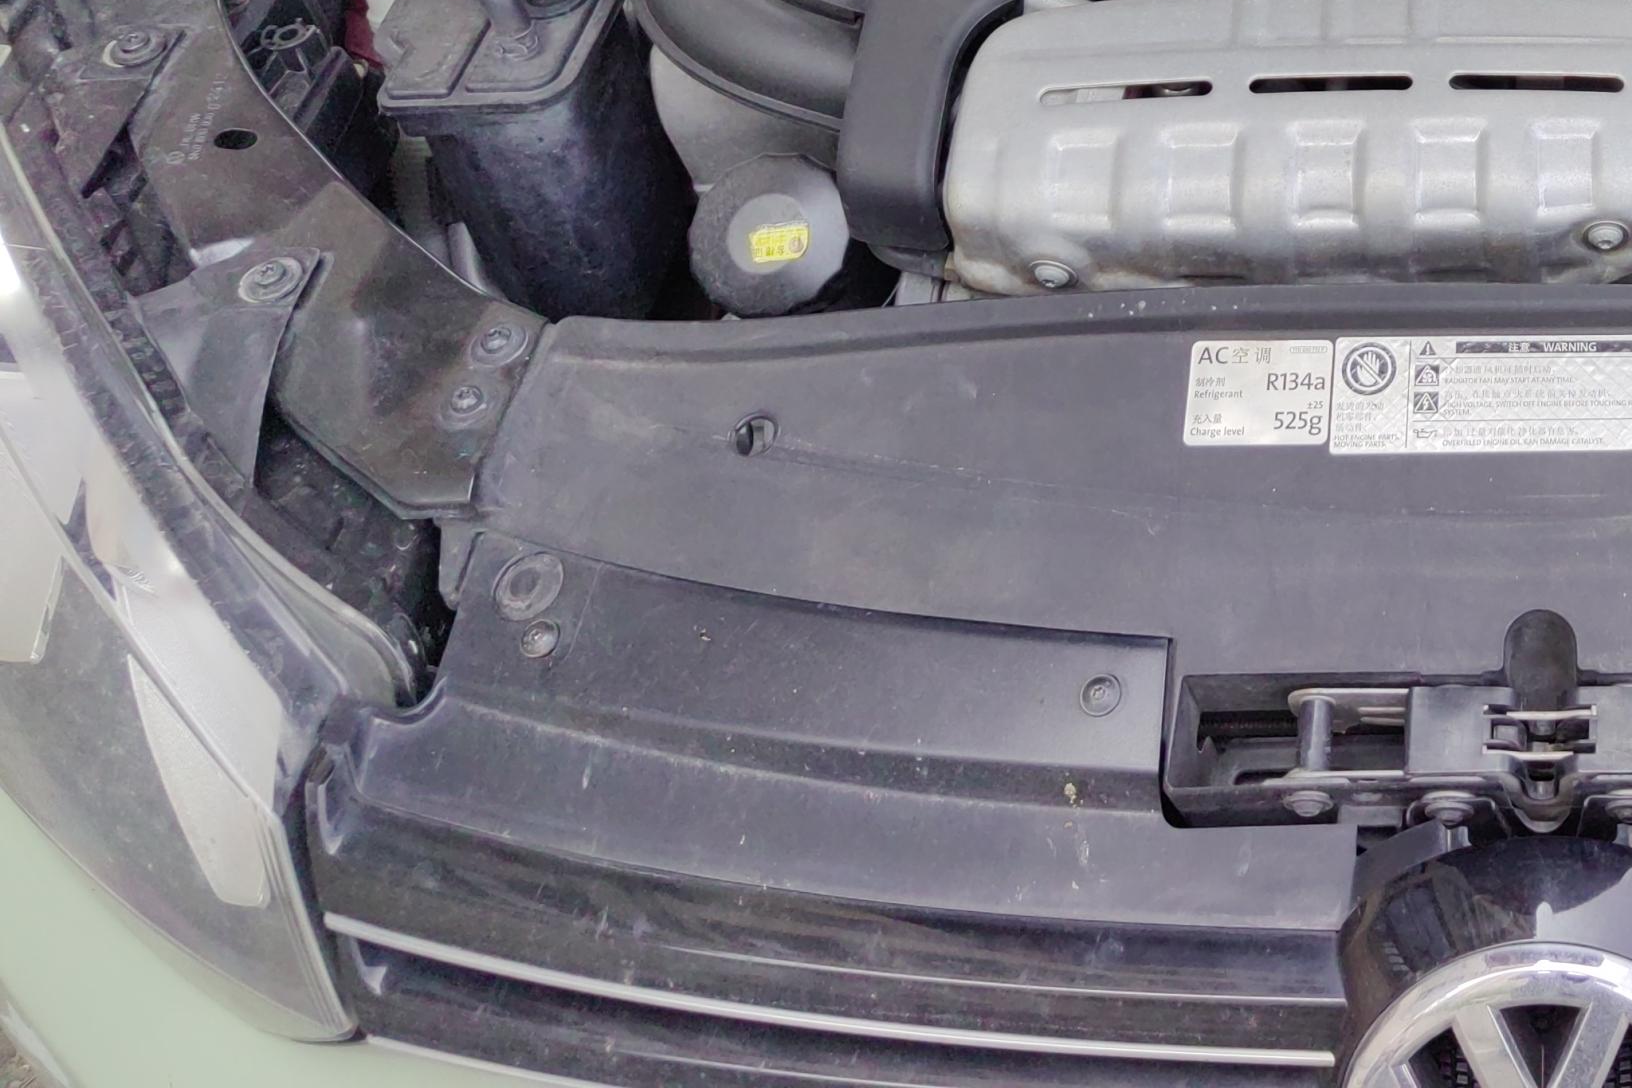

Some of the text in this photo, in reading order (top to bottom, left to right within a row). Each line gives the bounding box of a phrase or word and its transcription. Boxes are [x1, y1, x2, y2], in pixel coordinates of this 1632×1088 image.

[1543, 341, 1598, 353] WARNING
[1197, 346, 1229, 364] AC
[1231, 347, 1272, 365] 空调
[1266, 372, 1326, 391] R134a
[1444, 377, 1478, 385] RADIATOR
[1493, 377, 1509, 385] MAY
[1541, 376, 1556, 384] ANY
[1194, 389, 1243, 400] Refrigerant
[1307, 401, 1324, 409] ±25
[1495, 400, 1522, 408] SWITCH
[1522, 400, 1535, 408] OFF
[1537, 400, 1562, 408] ENGINE
[1563, 400, 1588, 408] BEFORE
[1590, 399, 1627, 408] TOUCHING
[1273, 411, 1323, 436] 525g
[1190, 426, 1245, 438] Charge level
[1334, 433, 1349, 441] HOT
[1351, 433, 1375, 441] ENGINE
[1442, 438, 1482, 446] OVERFILLED
[1483, 438, 1509, 446] ENGINE
[1523, 438, 1539, 446] CAN
[1540, 437, 1569, 445] DAMAGE
